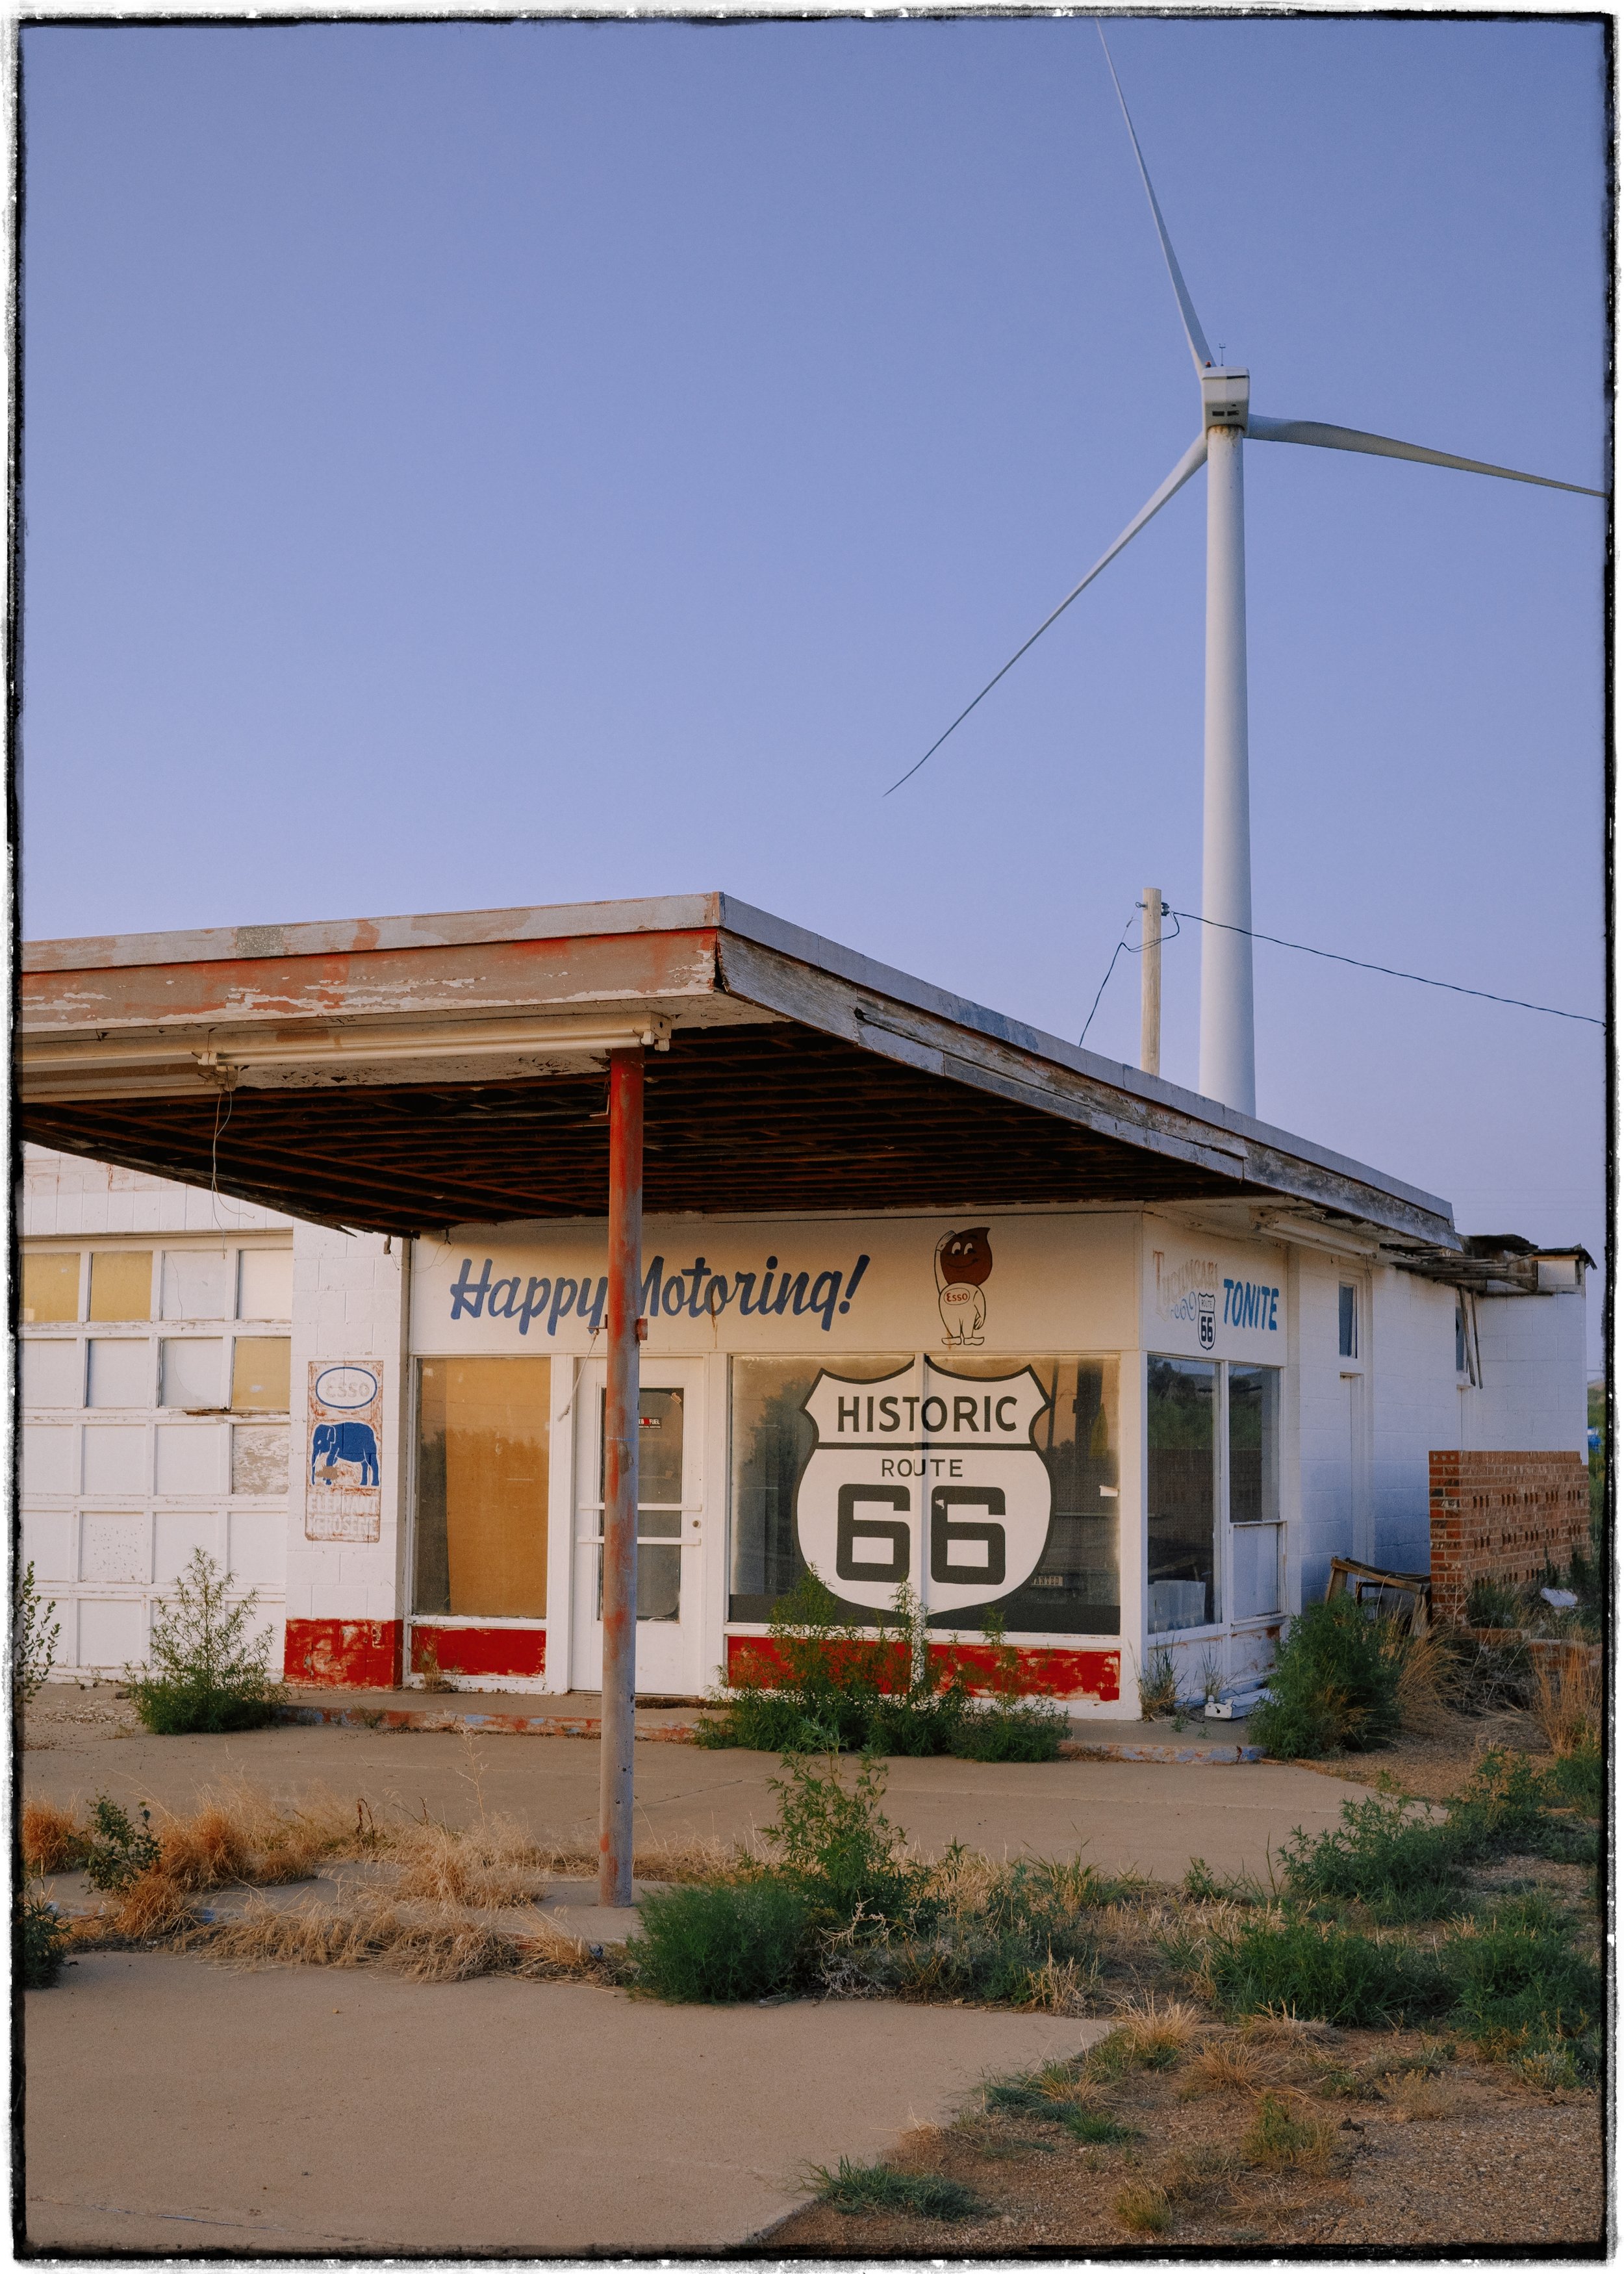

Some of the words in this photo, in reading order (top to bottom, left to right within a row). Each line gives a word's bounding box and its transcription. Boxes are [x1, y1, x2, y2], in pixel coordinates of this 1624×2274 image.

[450, 1258, 609, 1336] Happy
[1200, 1299, 1213, 1309] ROUTE
[1223, 1278, 1280, 1331] TONITE
[1200, 1316, 1213, 1343] 66
[837, 1395, 1019, 1433] HISTORIC
[881, 1458, 963, 1478] ROUTE
[835, 1483, 1007, 1585] 66
